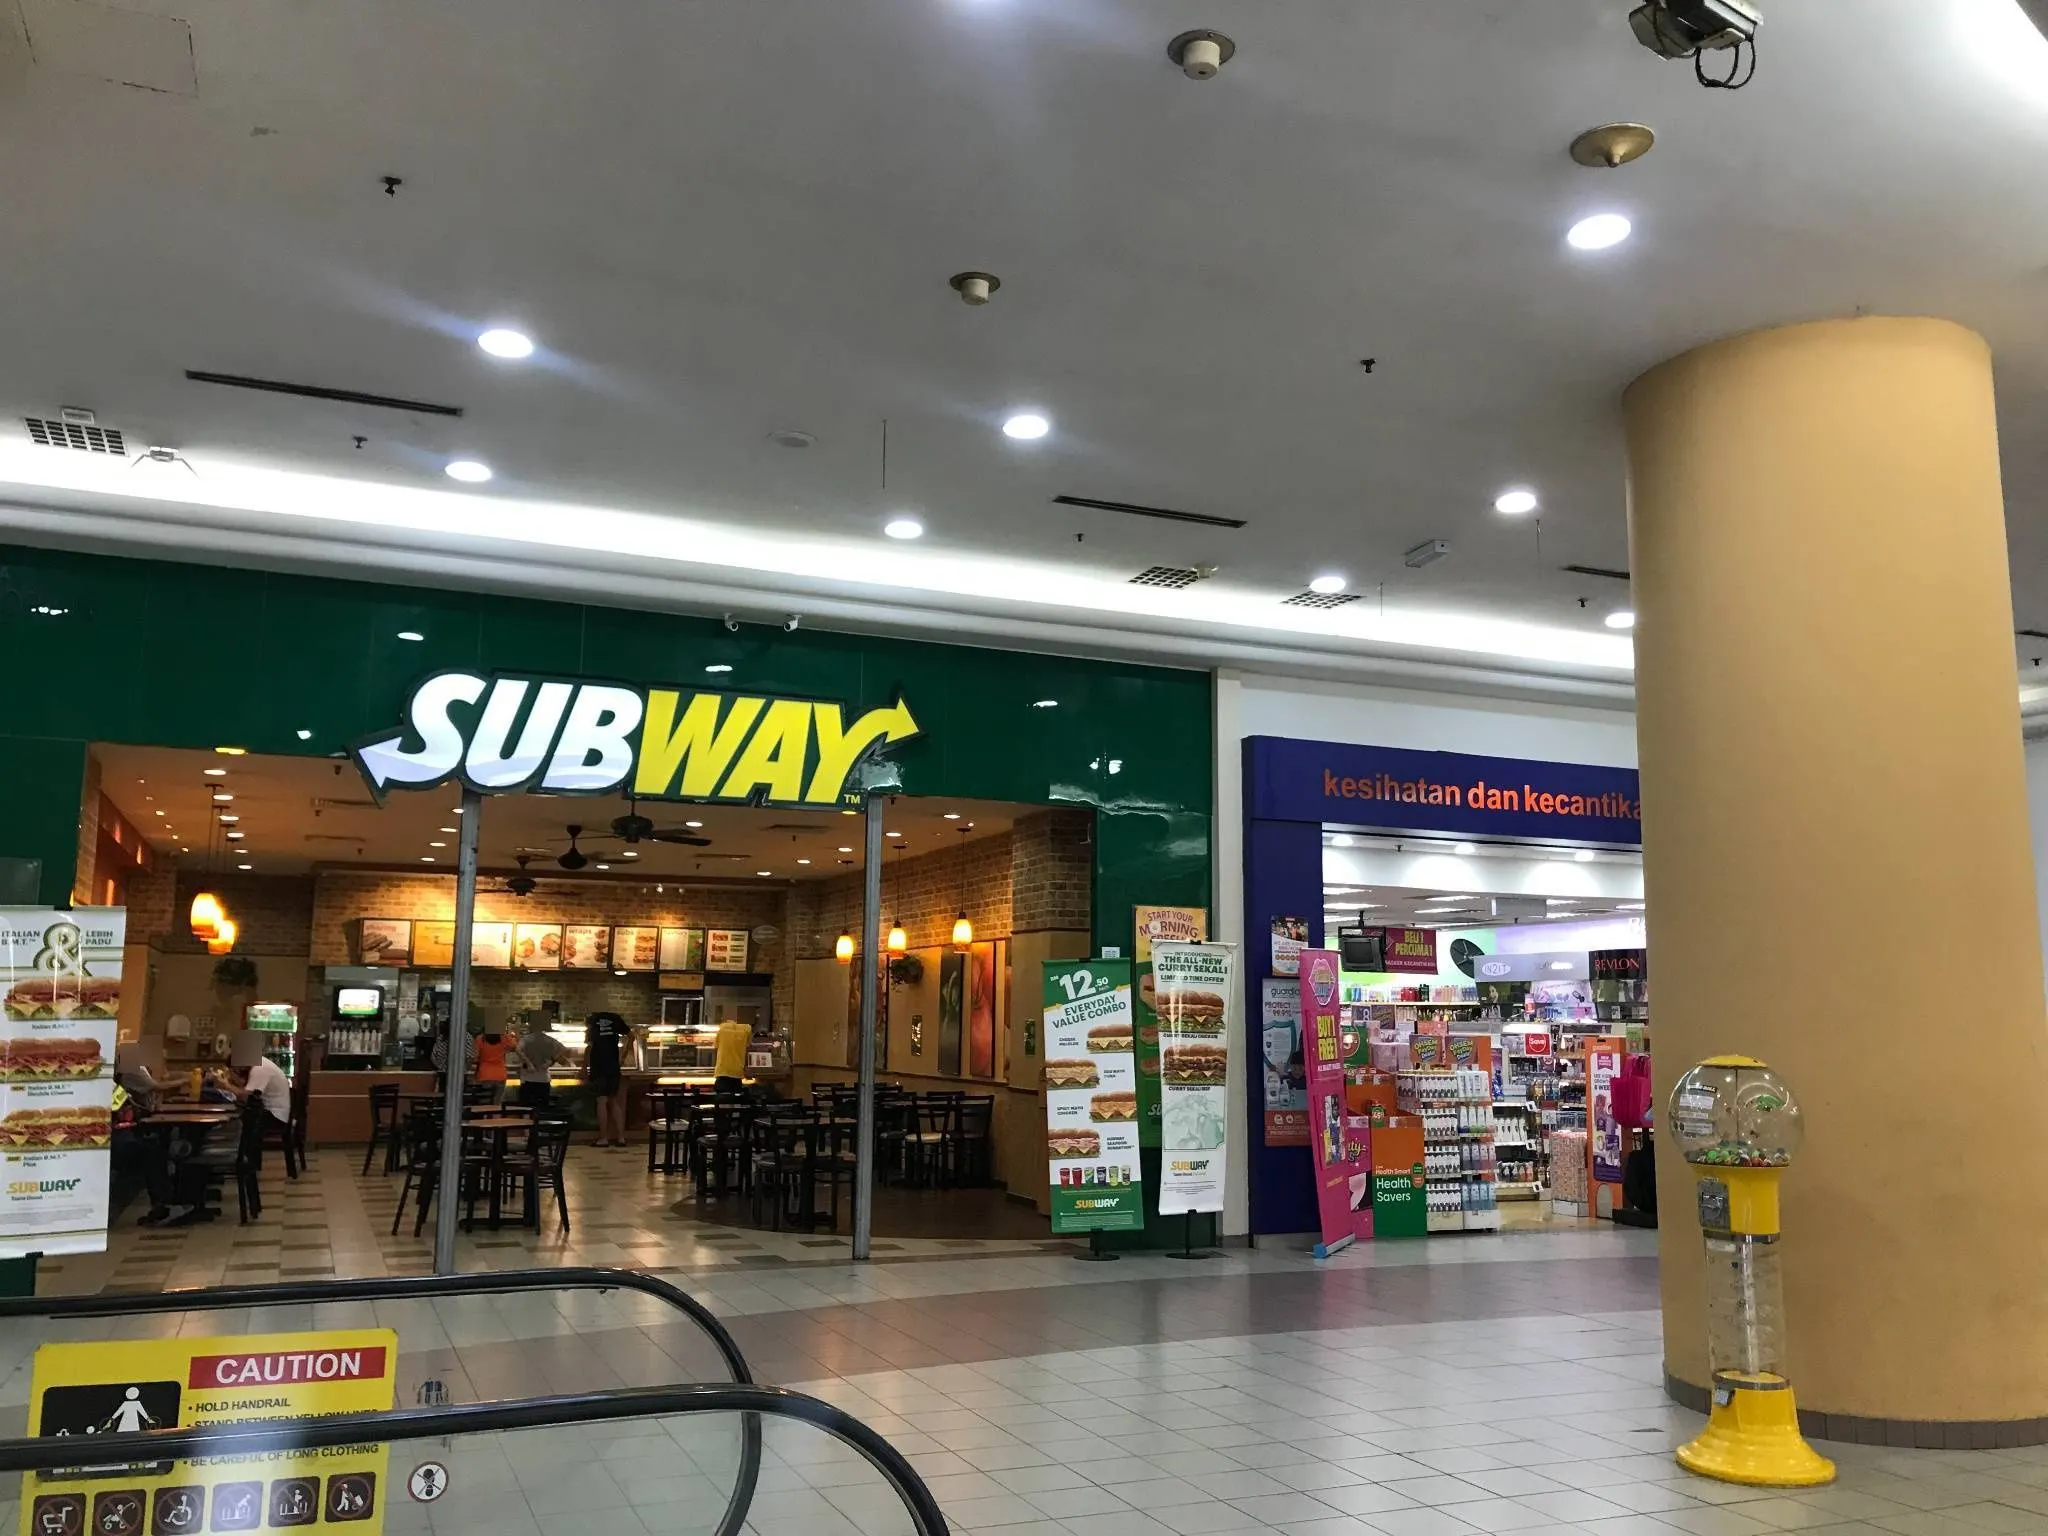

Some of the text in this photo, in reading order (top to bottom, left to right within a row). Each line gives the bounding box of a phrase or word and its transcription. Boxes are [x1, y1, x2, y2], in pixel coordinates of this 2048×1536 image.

[357, 673, 921, 804] SUBWAY
[1323, 768, 1461, 807] kesihatan
[1467, 781, 1519, 811] dan
[1147, 911, 1194, 922] START YOUR
[1, 930, 41, 938] ITALIAN
[1163, 956, 1223, 966] THE ALL-NEW
[1594, 957, 1640, 971] REVLON
[1158, 963, 1228, 975] CURRY SEKALI
[1064, 995, 1116, 1017] EVERYDAY
[1052, 1001, 1127, 1029] VALUE COMBO
[1170, 1159, 1210, 1171] SUBWAY
[6, 1178, 82, 1194] SUBWAY
[1376, 1176, 1411, 1189] Health
[1074, 1198, 1120, 1209] SUBWAY
[1376, 1191, 1411, 1202] Savers
[215, 1351, 362, 1385] CAUTION
[195, 1397, 291, 1413] HOLD HANDRAIL
[190, 1443, 379, 1467] BE CAREFUL OF LONG CLOTHING
